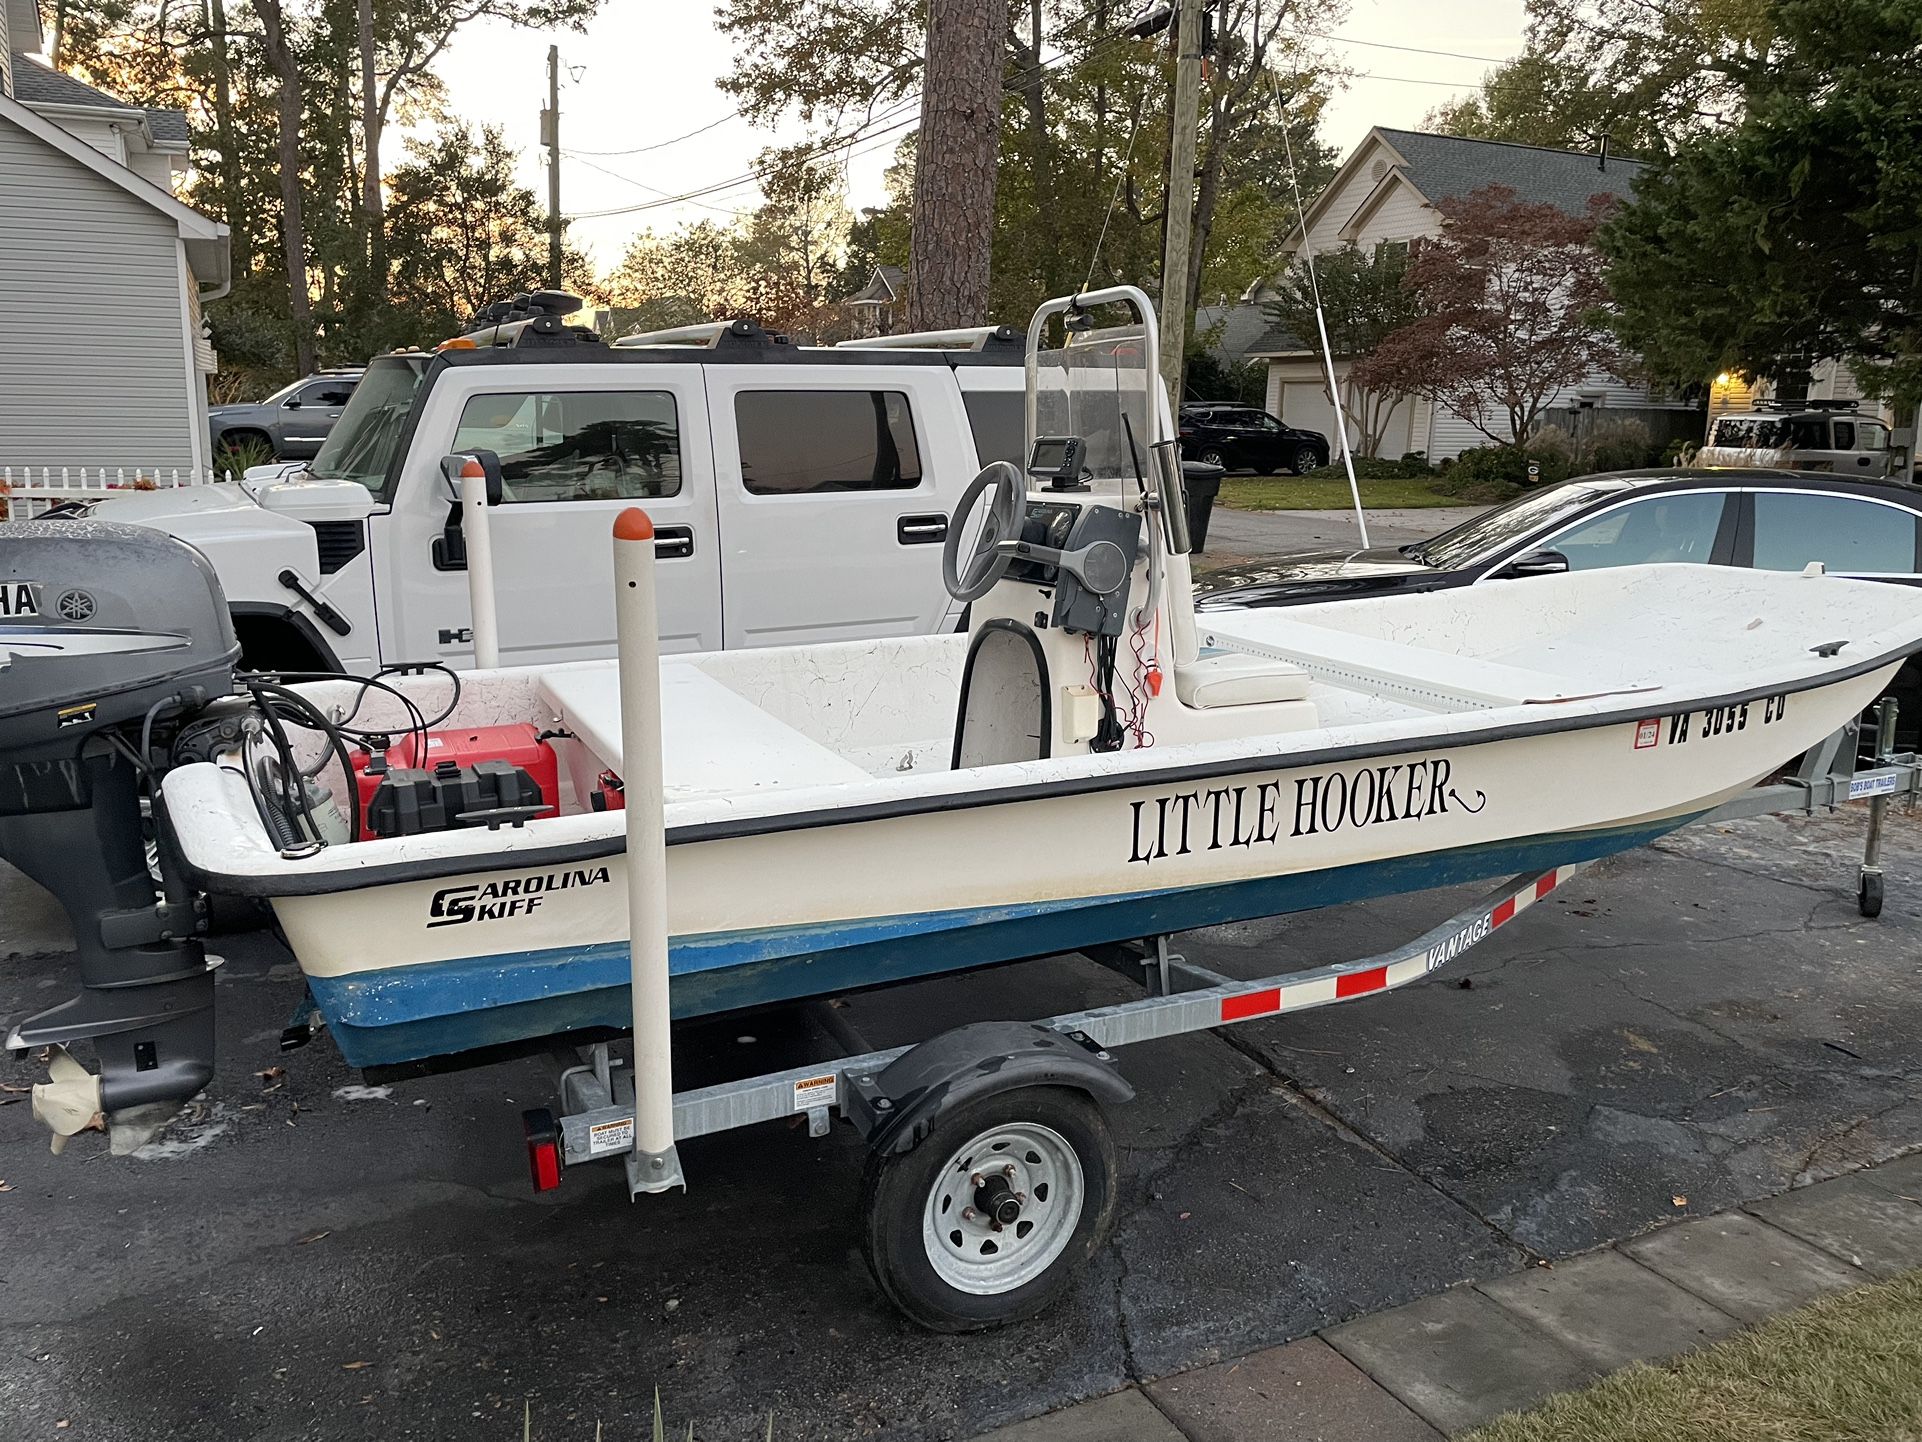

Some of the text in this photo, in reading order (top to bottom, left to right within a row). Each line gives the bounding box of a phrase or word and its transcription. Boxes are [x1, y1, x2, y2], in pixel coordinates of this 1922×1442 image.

[1669, 712, 1690, 744] VA
[1702, 703, 1749, 738] 3055
[1863, 779, 1875, 790] BOAT
[1876, 776, 1895, 787] TRAILERS
[1127, 757, 1452, 866] LITTLE HOOKER
[430, 867, 610, 917] CAROLINA
[1428, 912, 1491, 971] VANTAGE
[804, 1077, 834, 1088] WARNING
